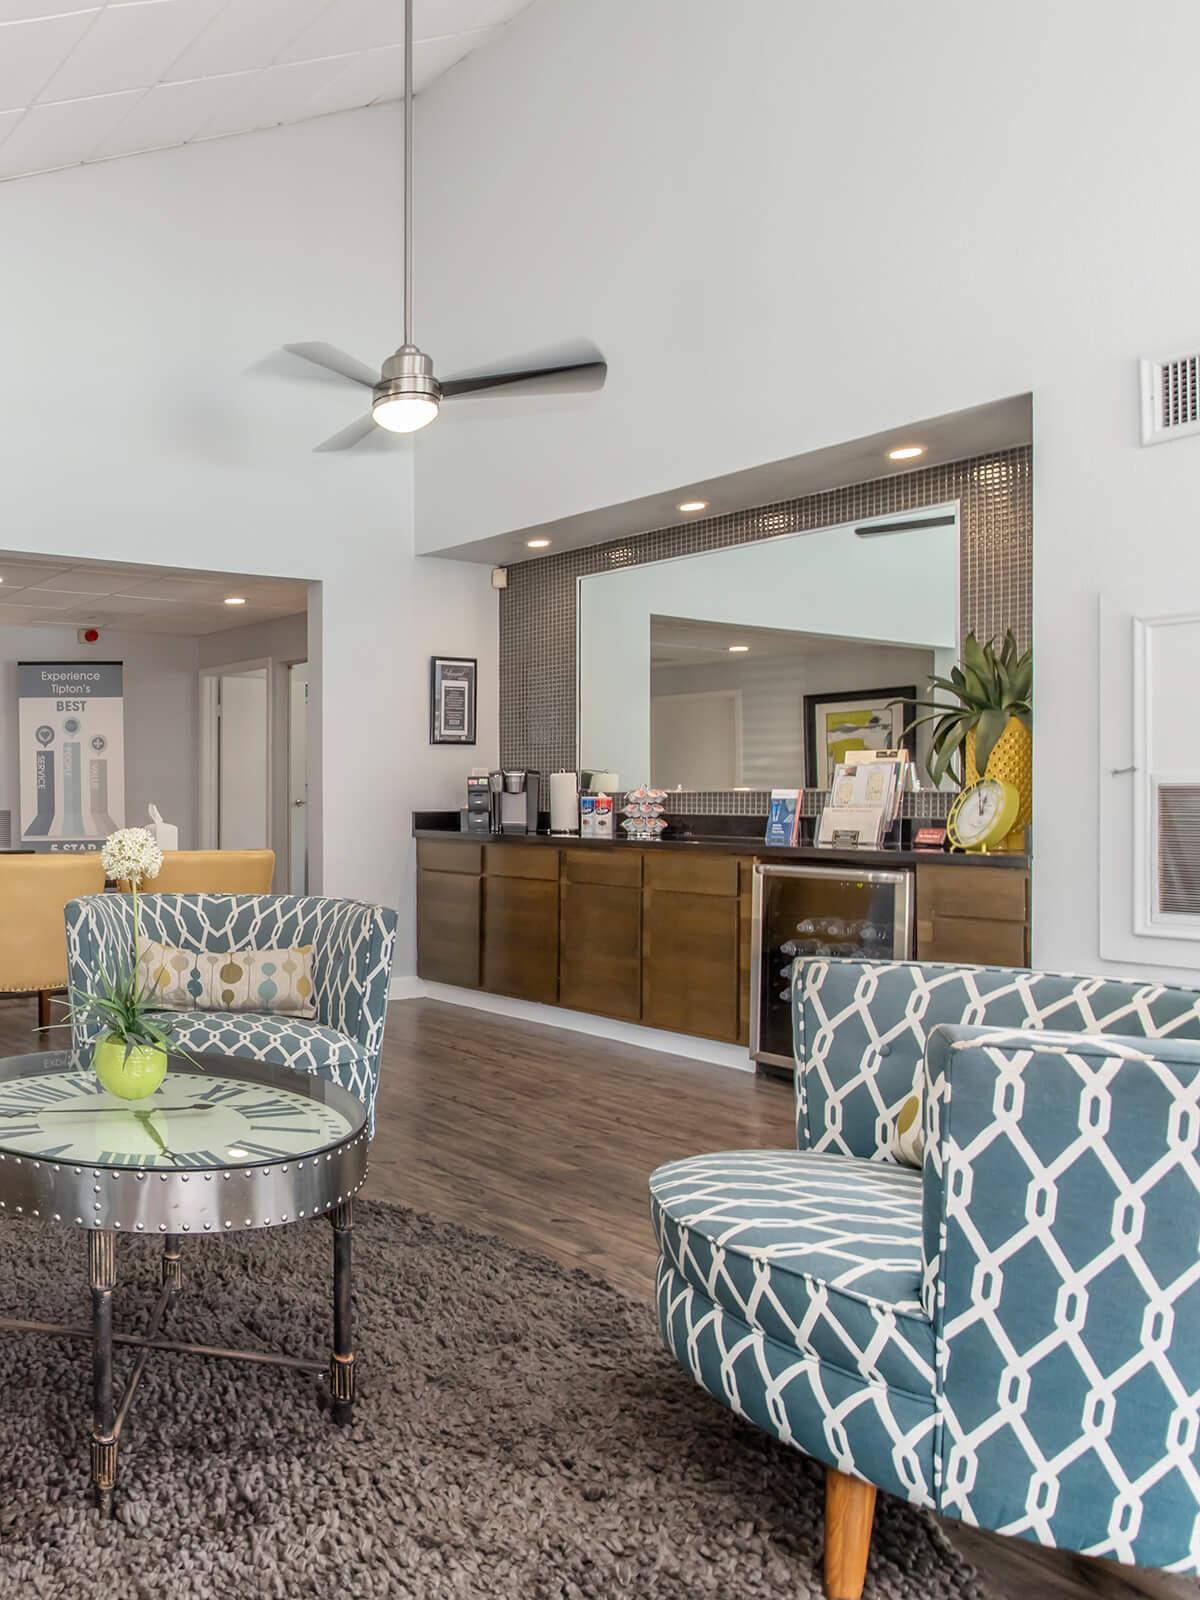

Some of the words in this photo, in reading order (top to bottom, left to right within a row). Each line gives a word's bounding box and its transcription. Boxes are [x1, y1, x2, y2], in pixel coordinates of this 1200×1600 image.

[41, 671, 101, 682] Experience
[51, 684, 91, 696] Tipton's
[56, 701, 87, 712] BEST
[37, 755, 46, 790] SERVICE
